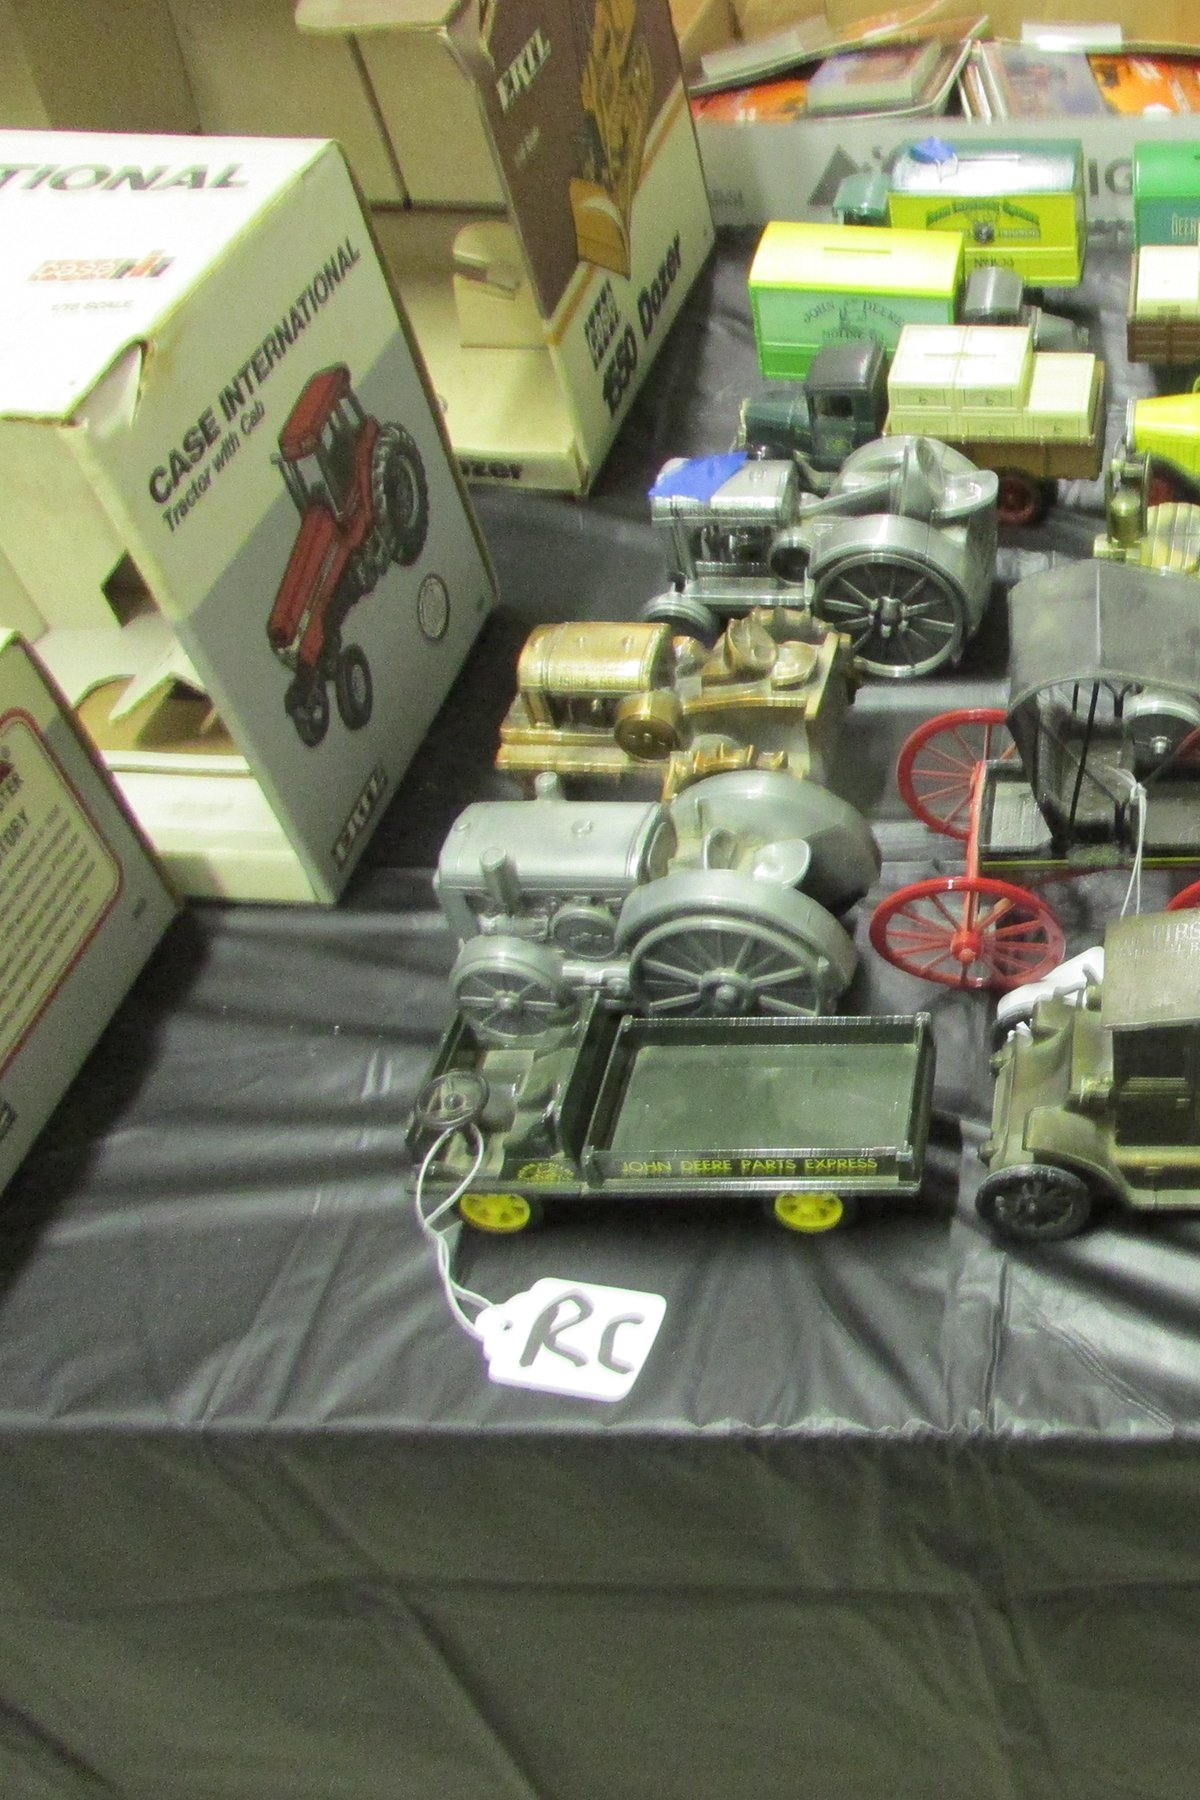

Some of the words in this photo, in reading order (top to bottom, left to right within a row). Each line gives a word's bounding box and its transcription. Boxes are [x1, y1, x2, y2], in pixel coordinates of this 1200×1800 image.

[637, 229, 681, 342] Dozer
[149, 406, 222, 504] CASE
[218, 237, 362, 422] INTERNATIONAL
[162, 473, 213, 533] Tractor
[211, 431, 241, 474] with
[623, 1160, 672, 1173] JOHN
[681, 1159, 732, 1171] DEERE
[741, 1159, 796, 1171] PARTS
[805, 1158, 878, 1170] EXPRESS
[519, 1288, 645, 1375] RC
